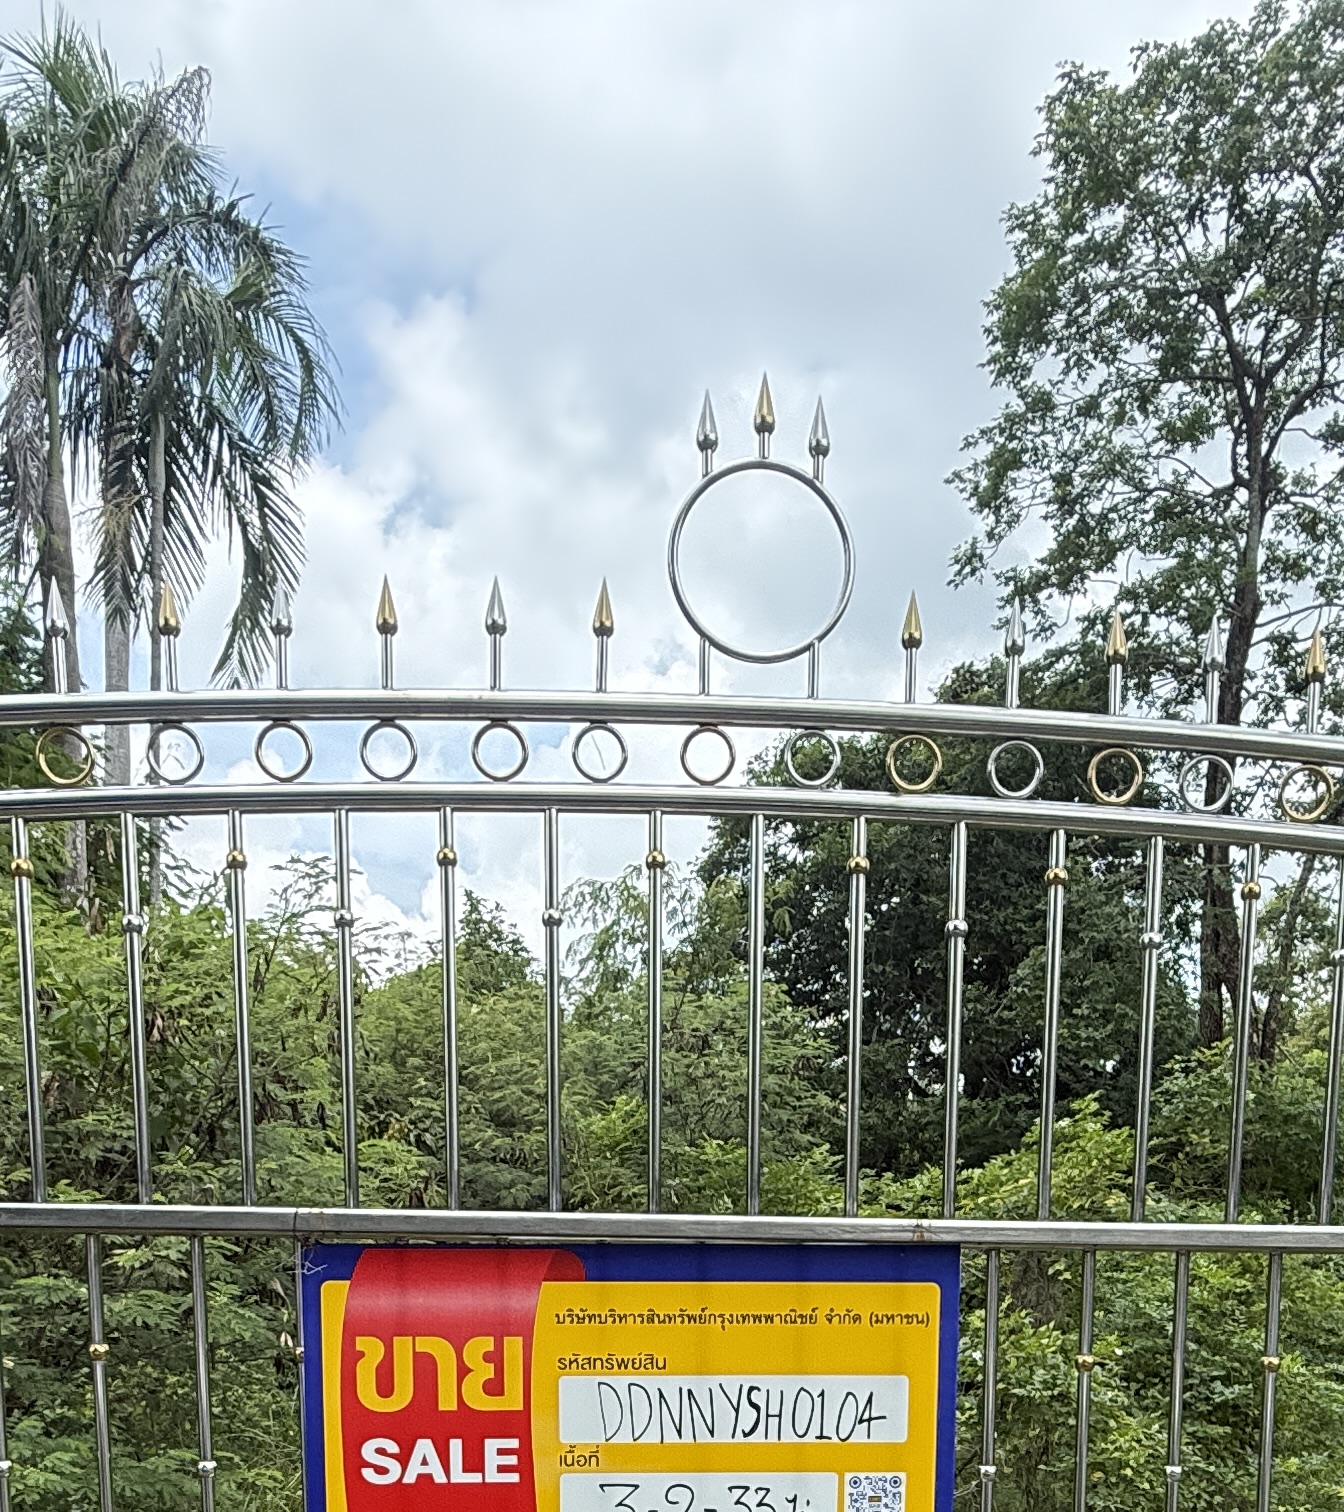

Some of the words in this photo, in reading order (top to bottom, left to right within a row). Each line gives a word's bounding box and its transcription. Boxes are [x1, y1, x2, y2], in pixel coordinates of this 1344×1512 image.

[554, 1306, 819, 1331] บริษัทบริหารสินทรัพย์กรุงเทพพาณิชย์
[824, 1308, 862, 1326] จำกัด
[868, 1311, 931, 1328] (มหาชน)
[556, 1351, 668, 1372] รหัสทรัพย์สิน
[355, 1336, 524, 1413] ขาย
[360, 1437, 521, 1485] SALE
[558, 1444, 600, 1468] เนื้อที่
